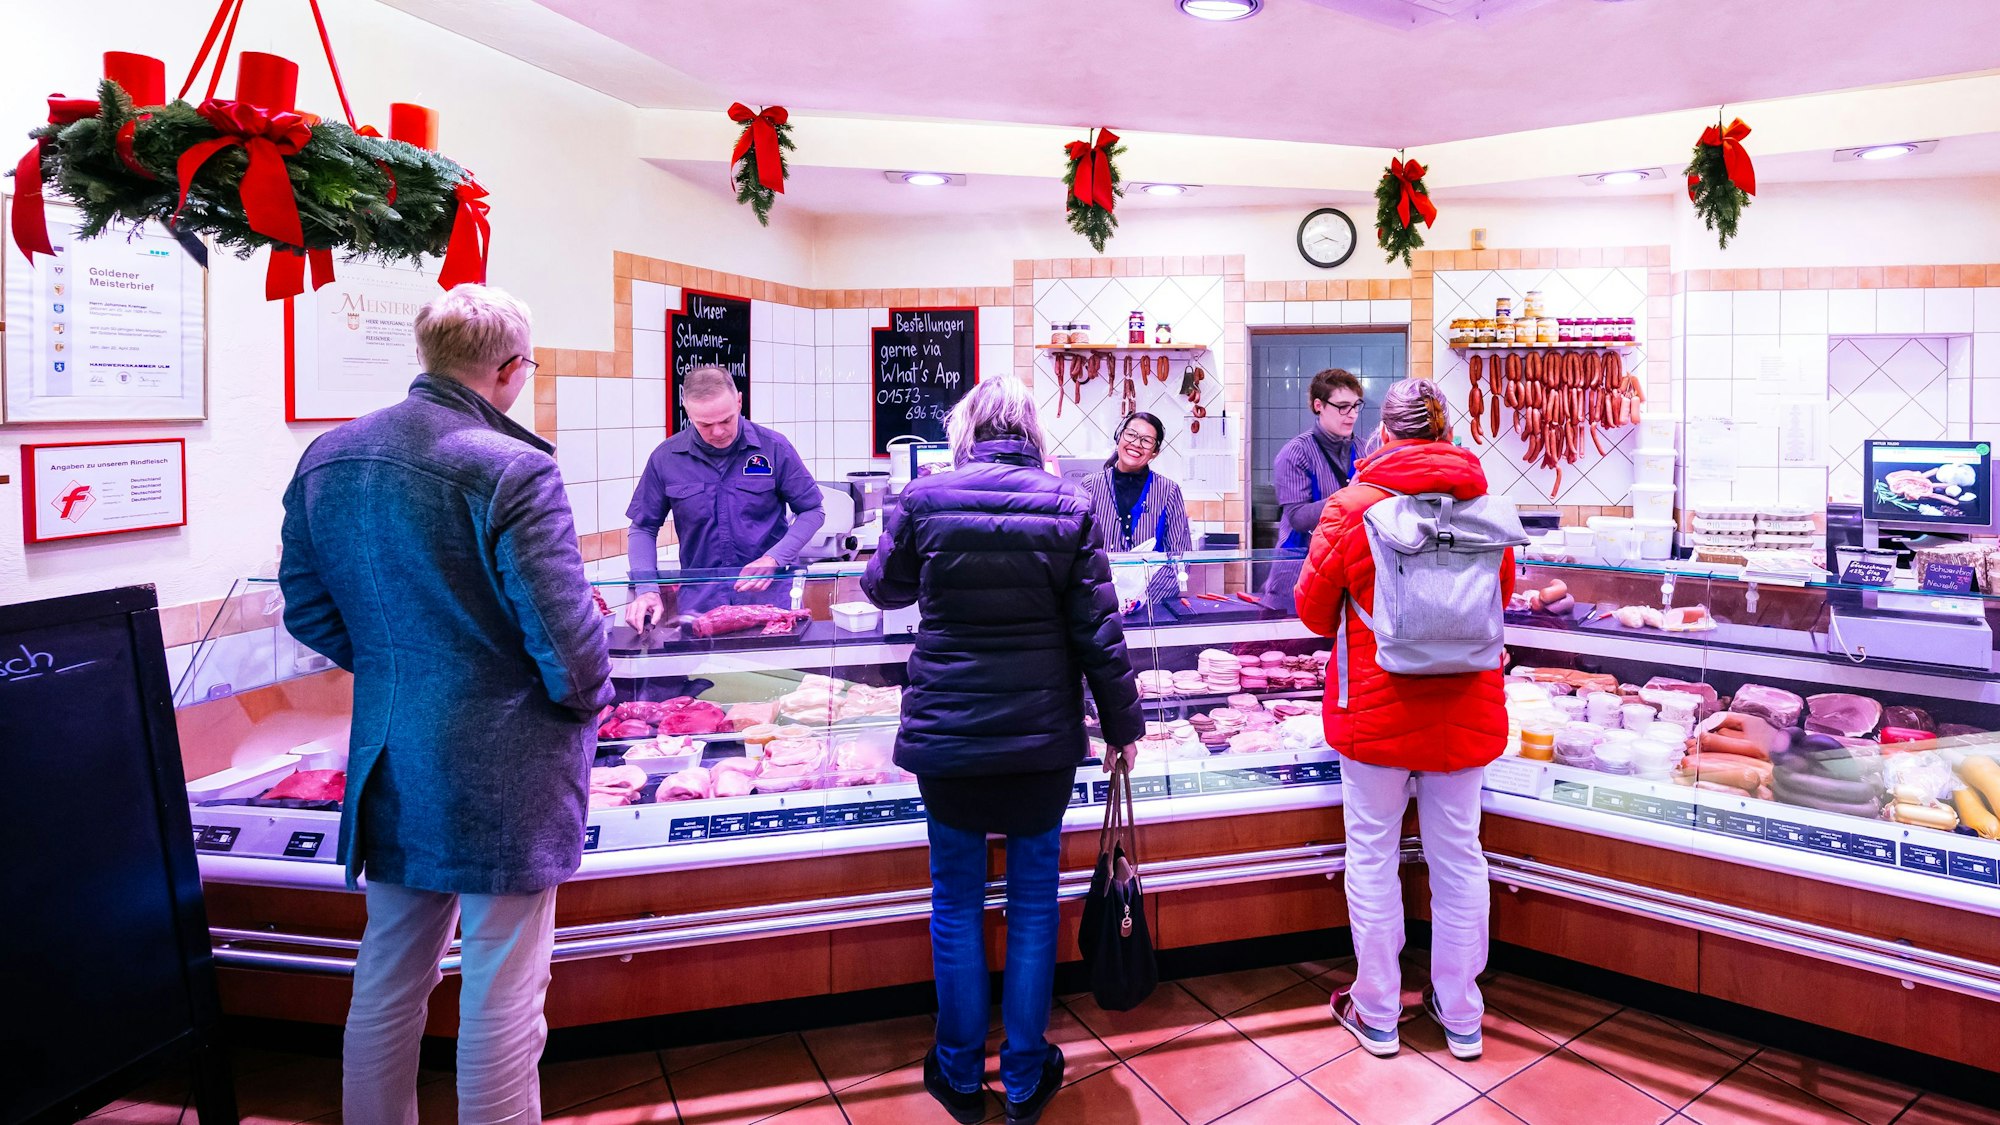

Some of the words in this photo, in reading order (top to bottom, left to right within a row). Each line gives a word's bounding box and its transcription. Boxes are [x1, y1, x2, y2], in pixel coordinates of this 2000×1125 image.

[89, 267, 140, 280] Goldener
[89, 278, 154, 291] Meisterbrief
[693, 296, 727, 320] Unser
[896, 312, 964, 339] Bestellungen
[880, 344, 918, 365] gerne
[922, 338, 941, 356] via
[728, 353, 746, 377] und
[881, 360, 929, 384] What's
[934, 362, 960, 390] App
